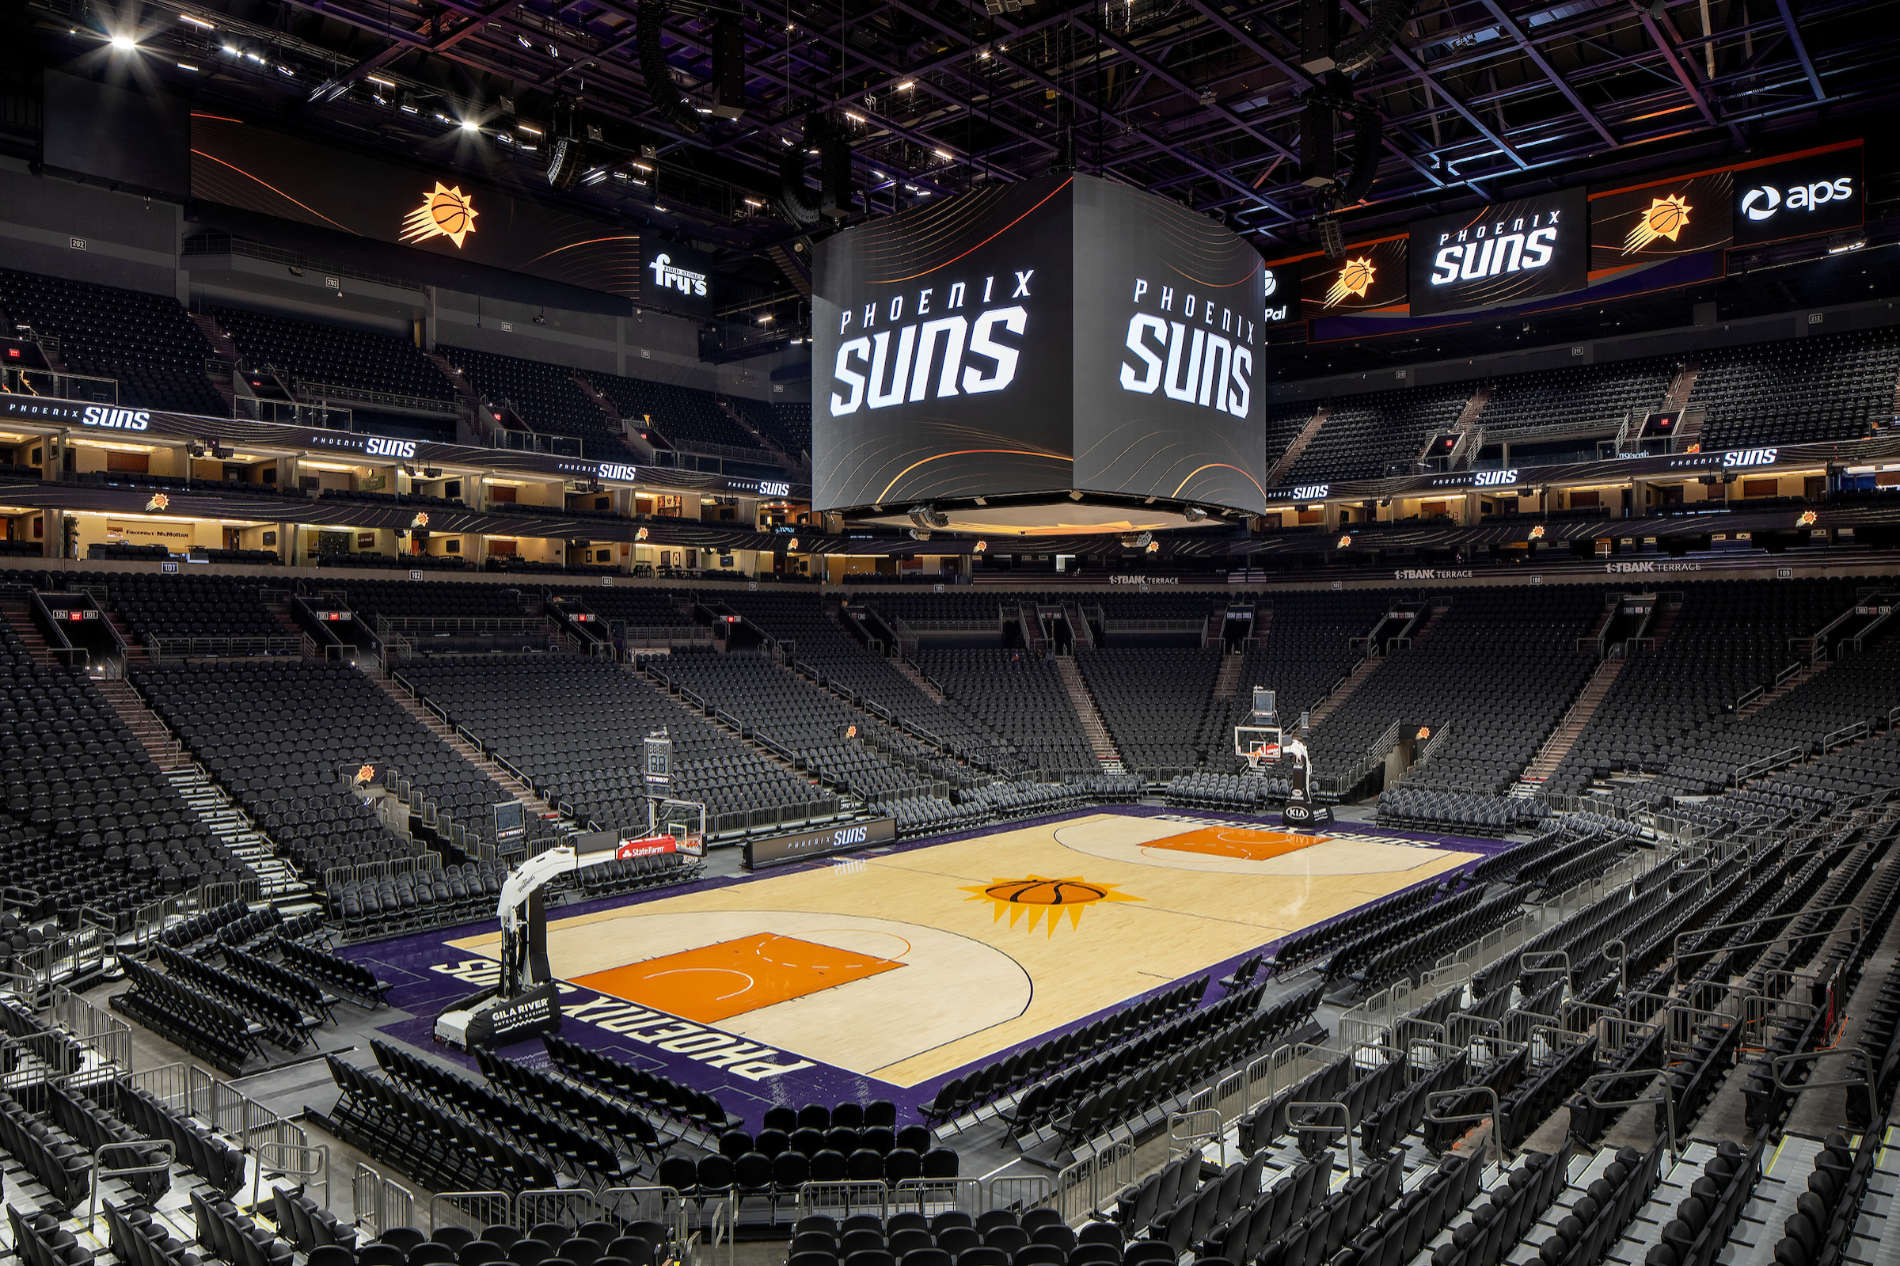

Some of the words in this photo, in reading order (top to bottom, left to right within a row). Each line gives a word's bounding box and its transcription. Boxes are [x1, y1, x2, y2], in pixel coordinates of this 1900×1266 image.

[1786, 177, 1853, 212] aps
[1440, 210, 1561, 246] PHOENIX
[1431, 226, 1557, 285] SUNS
[649, 253, 707, 296] fry's
[839, 269, 1034, 335] PHOENIX
[1133, 278, 1255, 345] PHOENIX
[830, 305, 1028, 417] SUNS
[1119, 312, 1253, 420] SUNS
[9, 404, 79, 418] PHOENIX
[82, 407, 151, 431] SUNS
[312, 436, 365, 448] PHOENIX
[366, 438, 417, 458] SUNS
[1723, 448, 1779, 468] SUNS
[598, 464, 637, 481] SUNS
[1474, 469, 1519, 486] SUNS
[760, 481, 790, 497] SUNS
[1293, 485, 1329, 500] SUNS
[1436, 569, 1473, 579] TERRACE
[1658, 562, 1702, 572] TERRACE
[1290, 808, 1305, 817] KIA
[833, 827, 868, 846] SUNS
[492, 1006, 517, 1022] GILA
[517, 999, 550, 1014] RIVER
[558, 995, 818, 1082] PHOENIX
